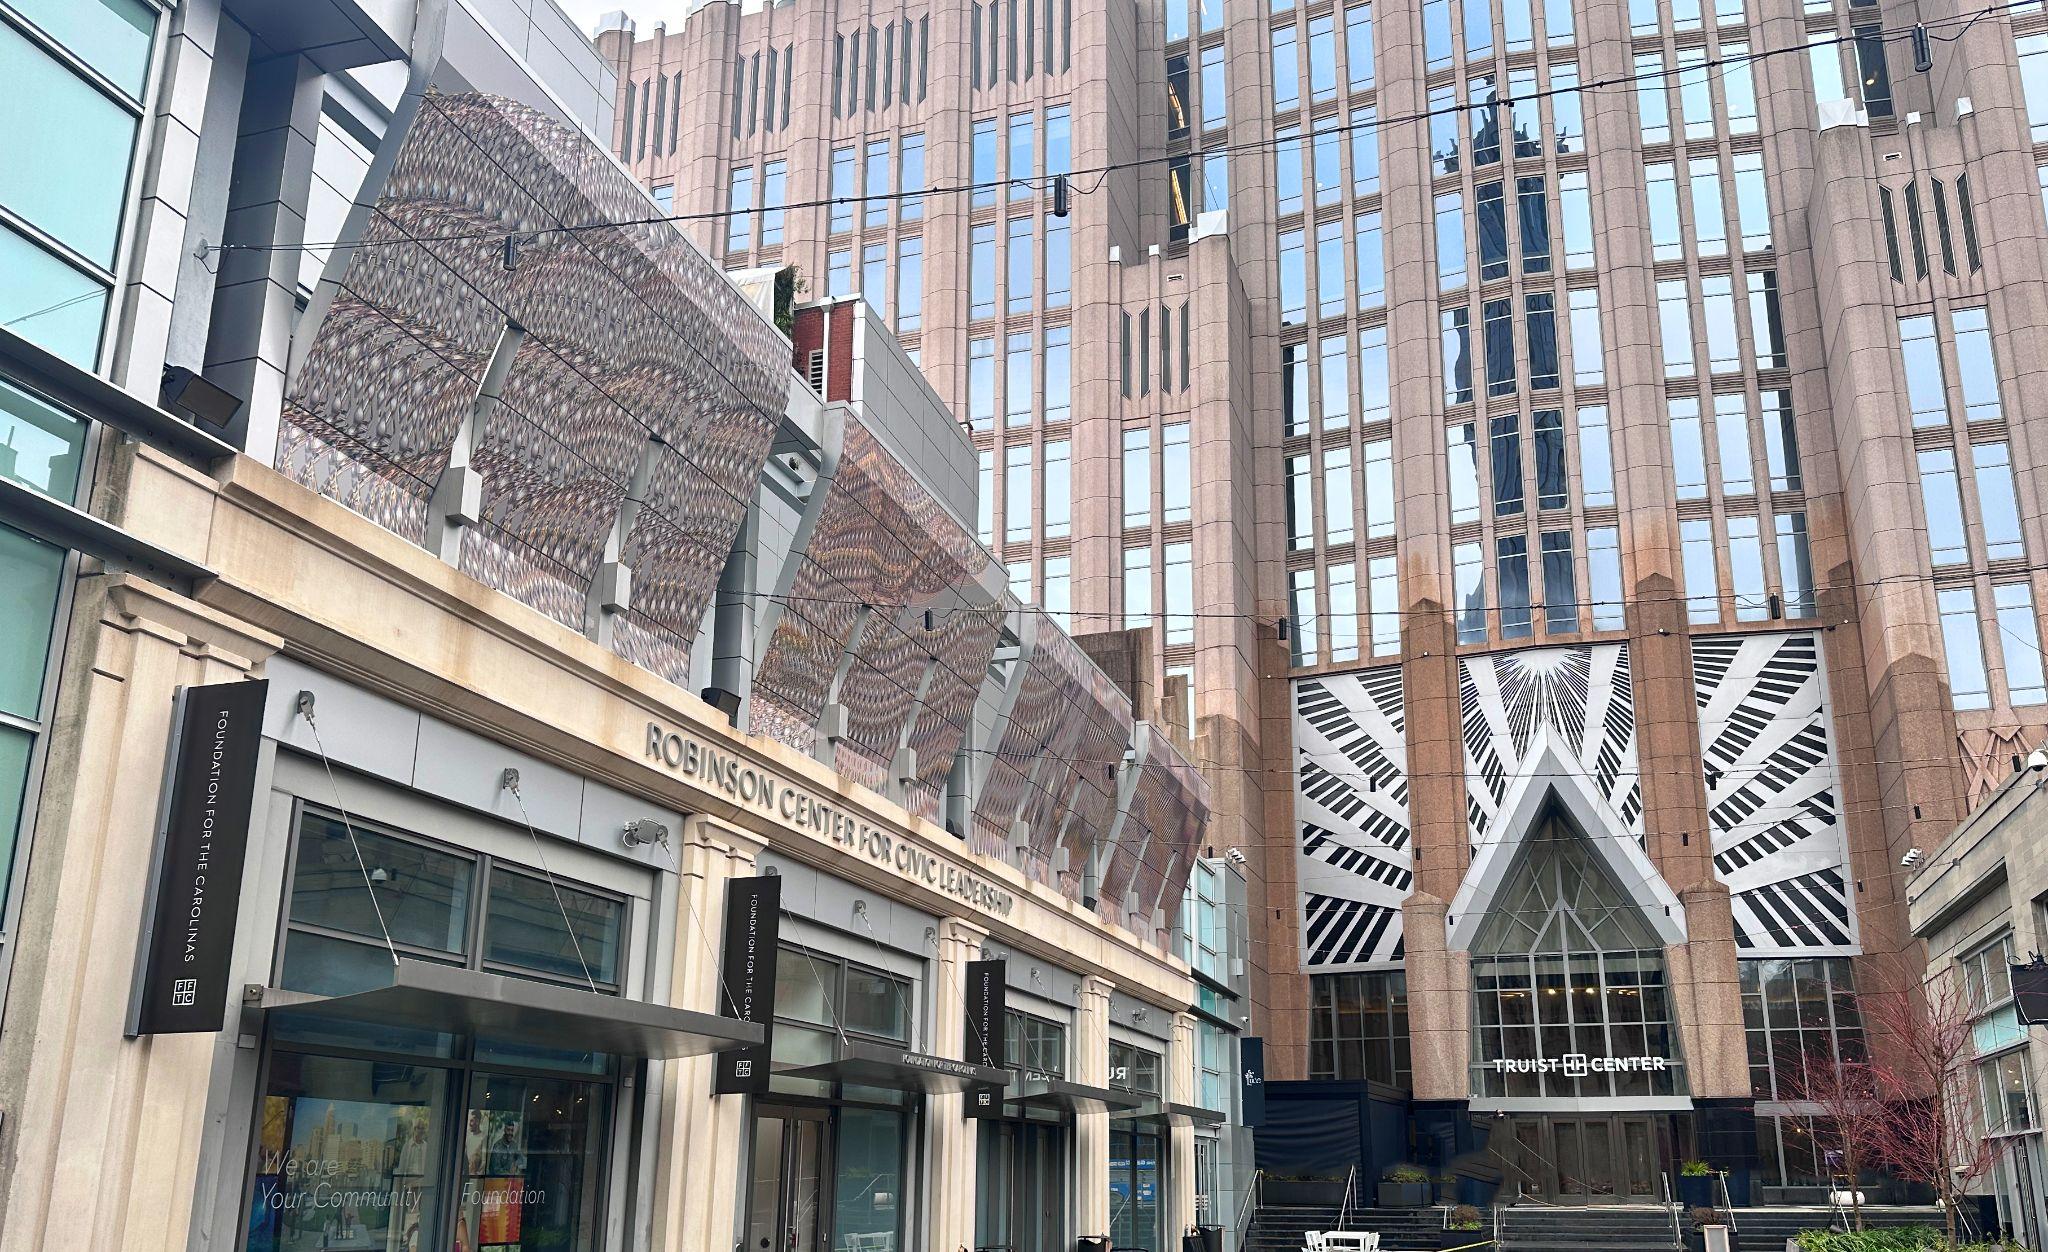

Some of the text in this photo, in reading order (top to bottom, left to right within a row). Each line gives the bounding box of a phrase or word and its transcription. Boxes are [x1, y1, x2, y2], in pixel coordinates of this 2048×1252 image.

[645, 721, 1013, 917] ROBINSON CENTER FOR CIVIC LEADERSHIP
[184, 710, 229, 962] FOUNDATION FOR THE CAROLINAS
[747, 894, 758, 953] FOUNDATION
[746, 955, 755, 974] FOR
[744, 977, 753, 993] THE
[1492, 1056, 1666, 1073] TRUIST CENTER
[262, 1150, 339, 1176] We are
[260, 1182, 546, 1212] Your Community Foundation
